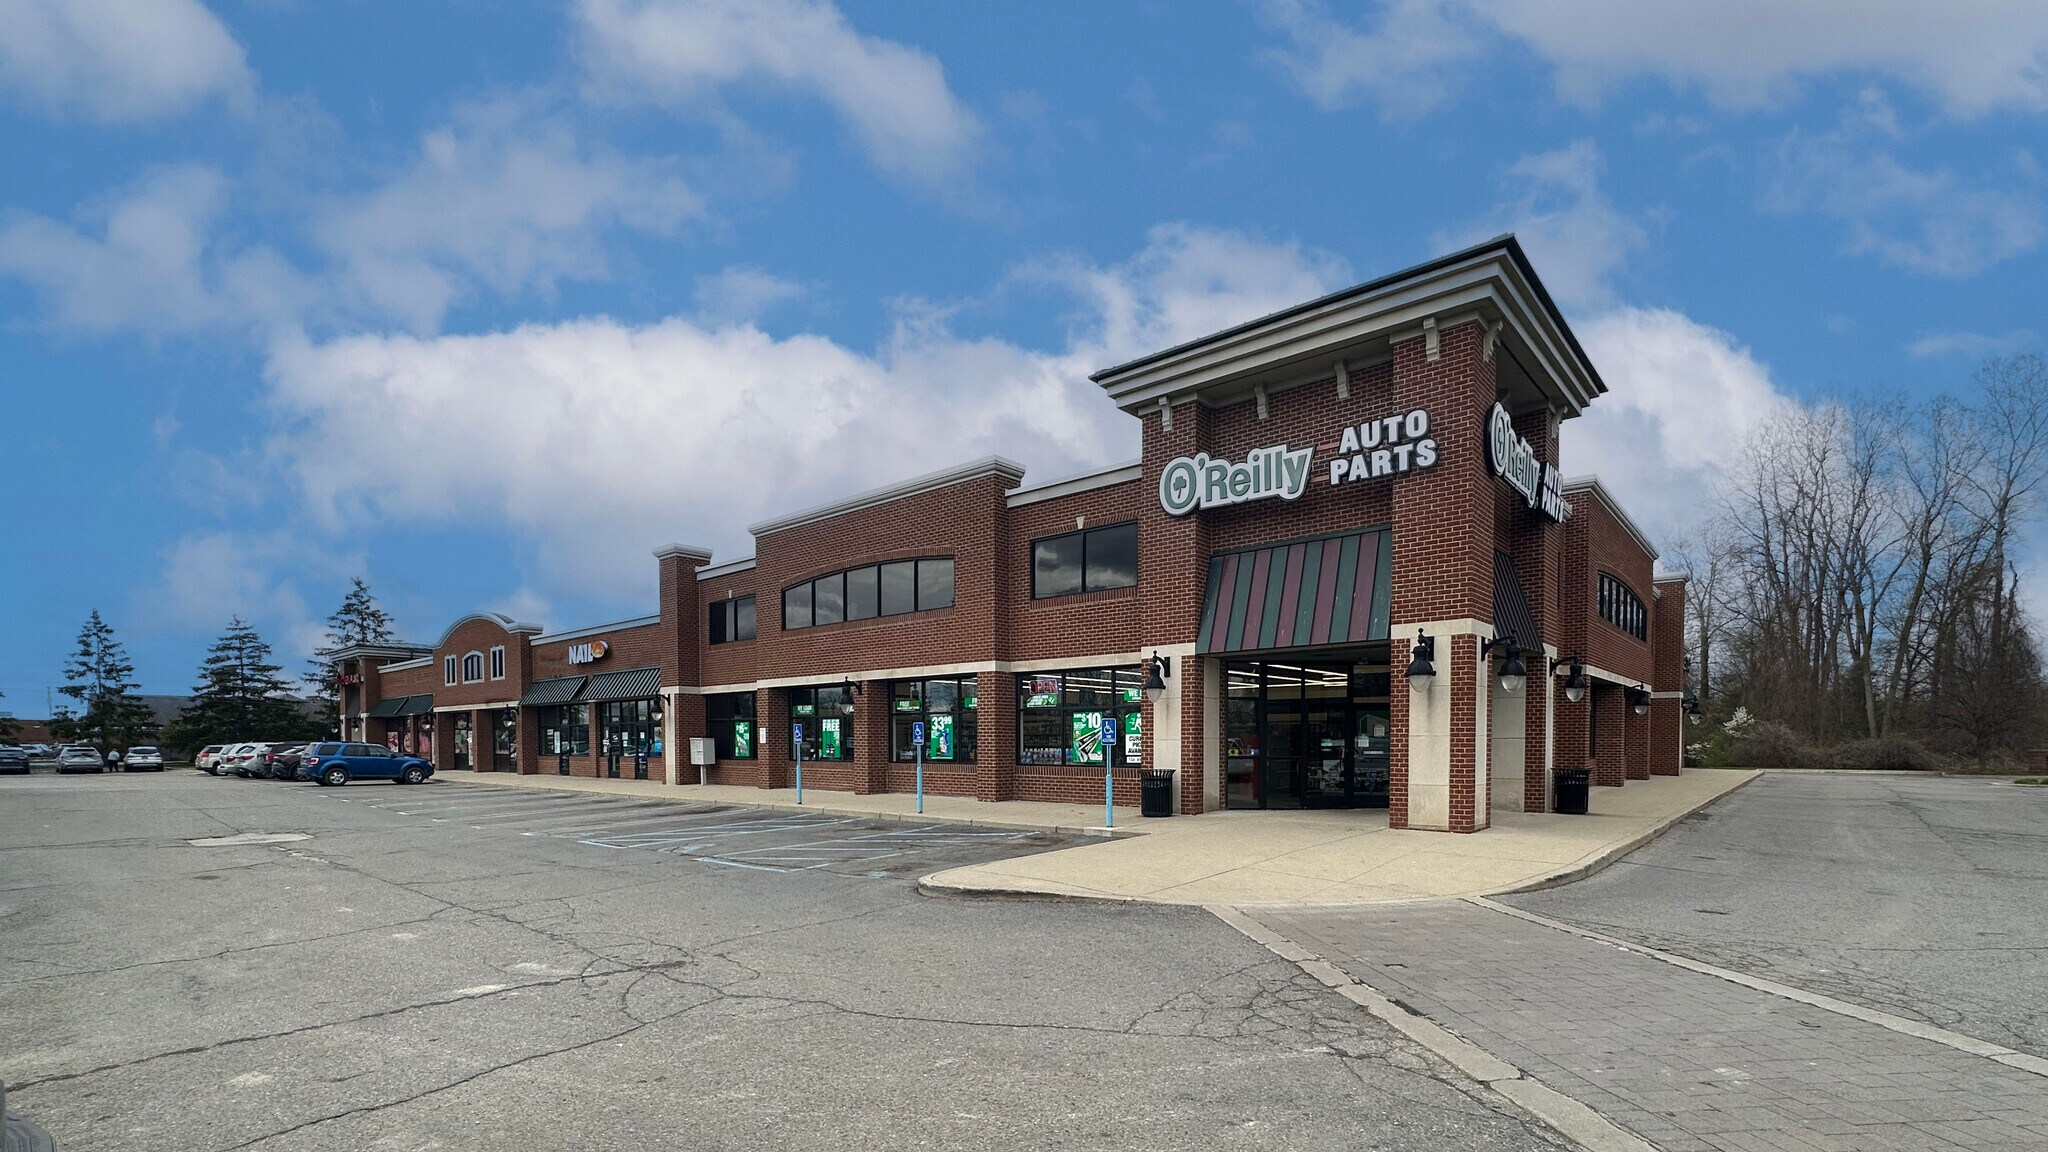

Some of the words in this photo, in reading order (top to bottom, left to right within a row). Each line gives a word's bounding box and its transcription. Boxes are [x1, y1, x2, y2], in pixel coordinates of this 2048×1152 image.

[1339, 409, 1429, 454] AUTO
[1330, 439, 1437, 485] PARTS
[1494, 408, 1540, 507] O'Reilly
[1162, 446, 1310, 512] O'Reilly
[1544, 462, 1564, 497] AUTO
[1542, 485, 1565, 523] PARTS
[1030, 680, 1057, 693] OPEN
[822, 722, 840, 732] FREE
